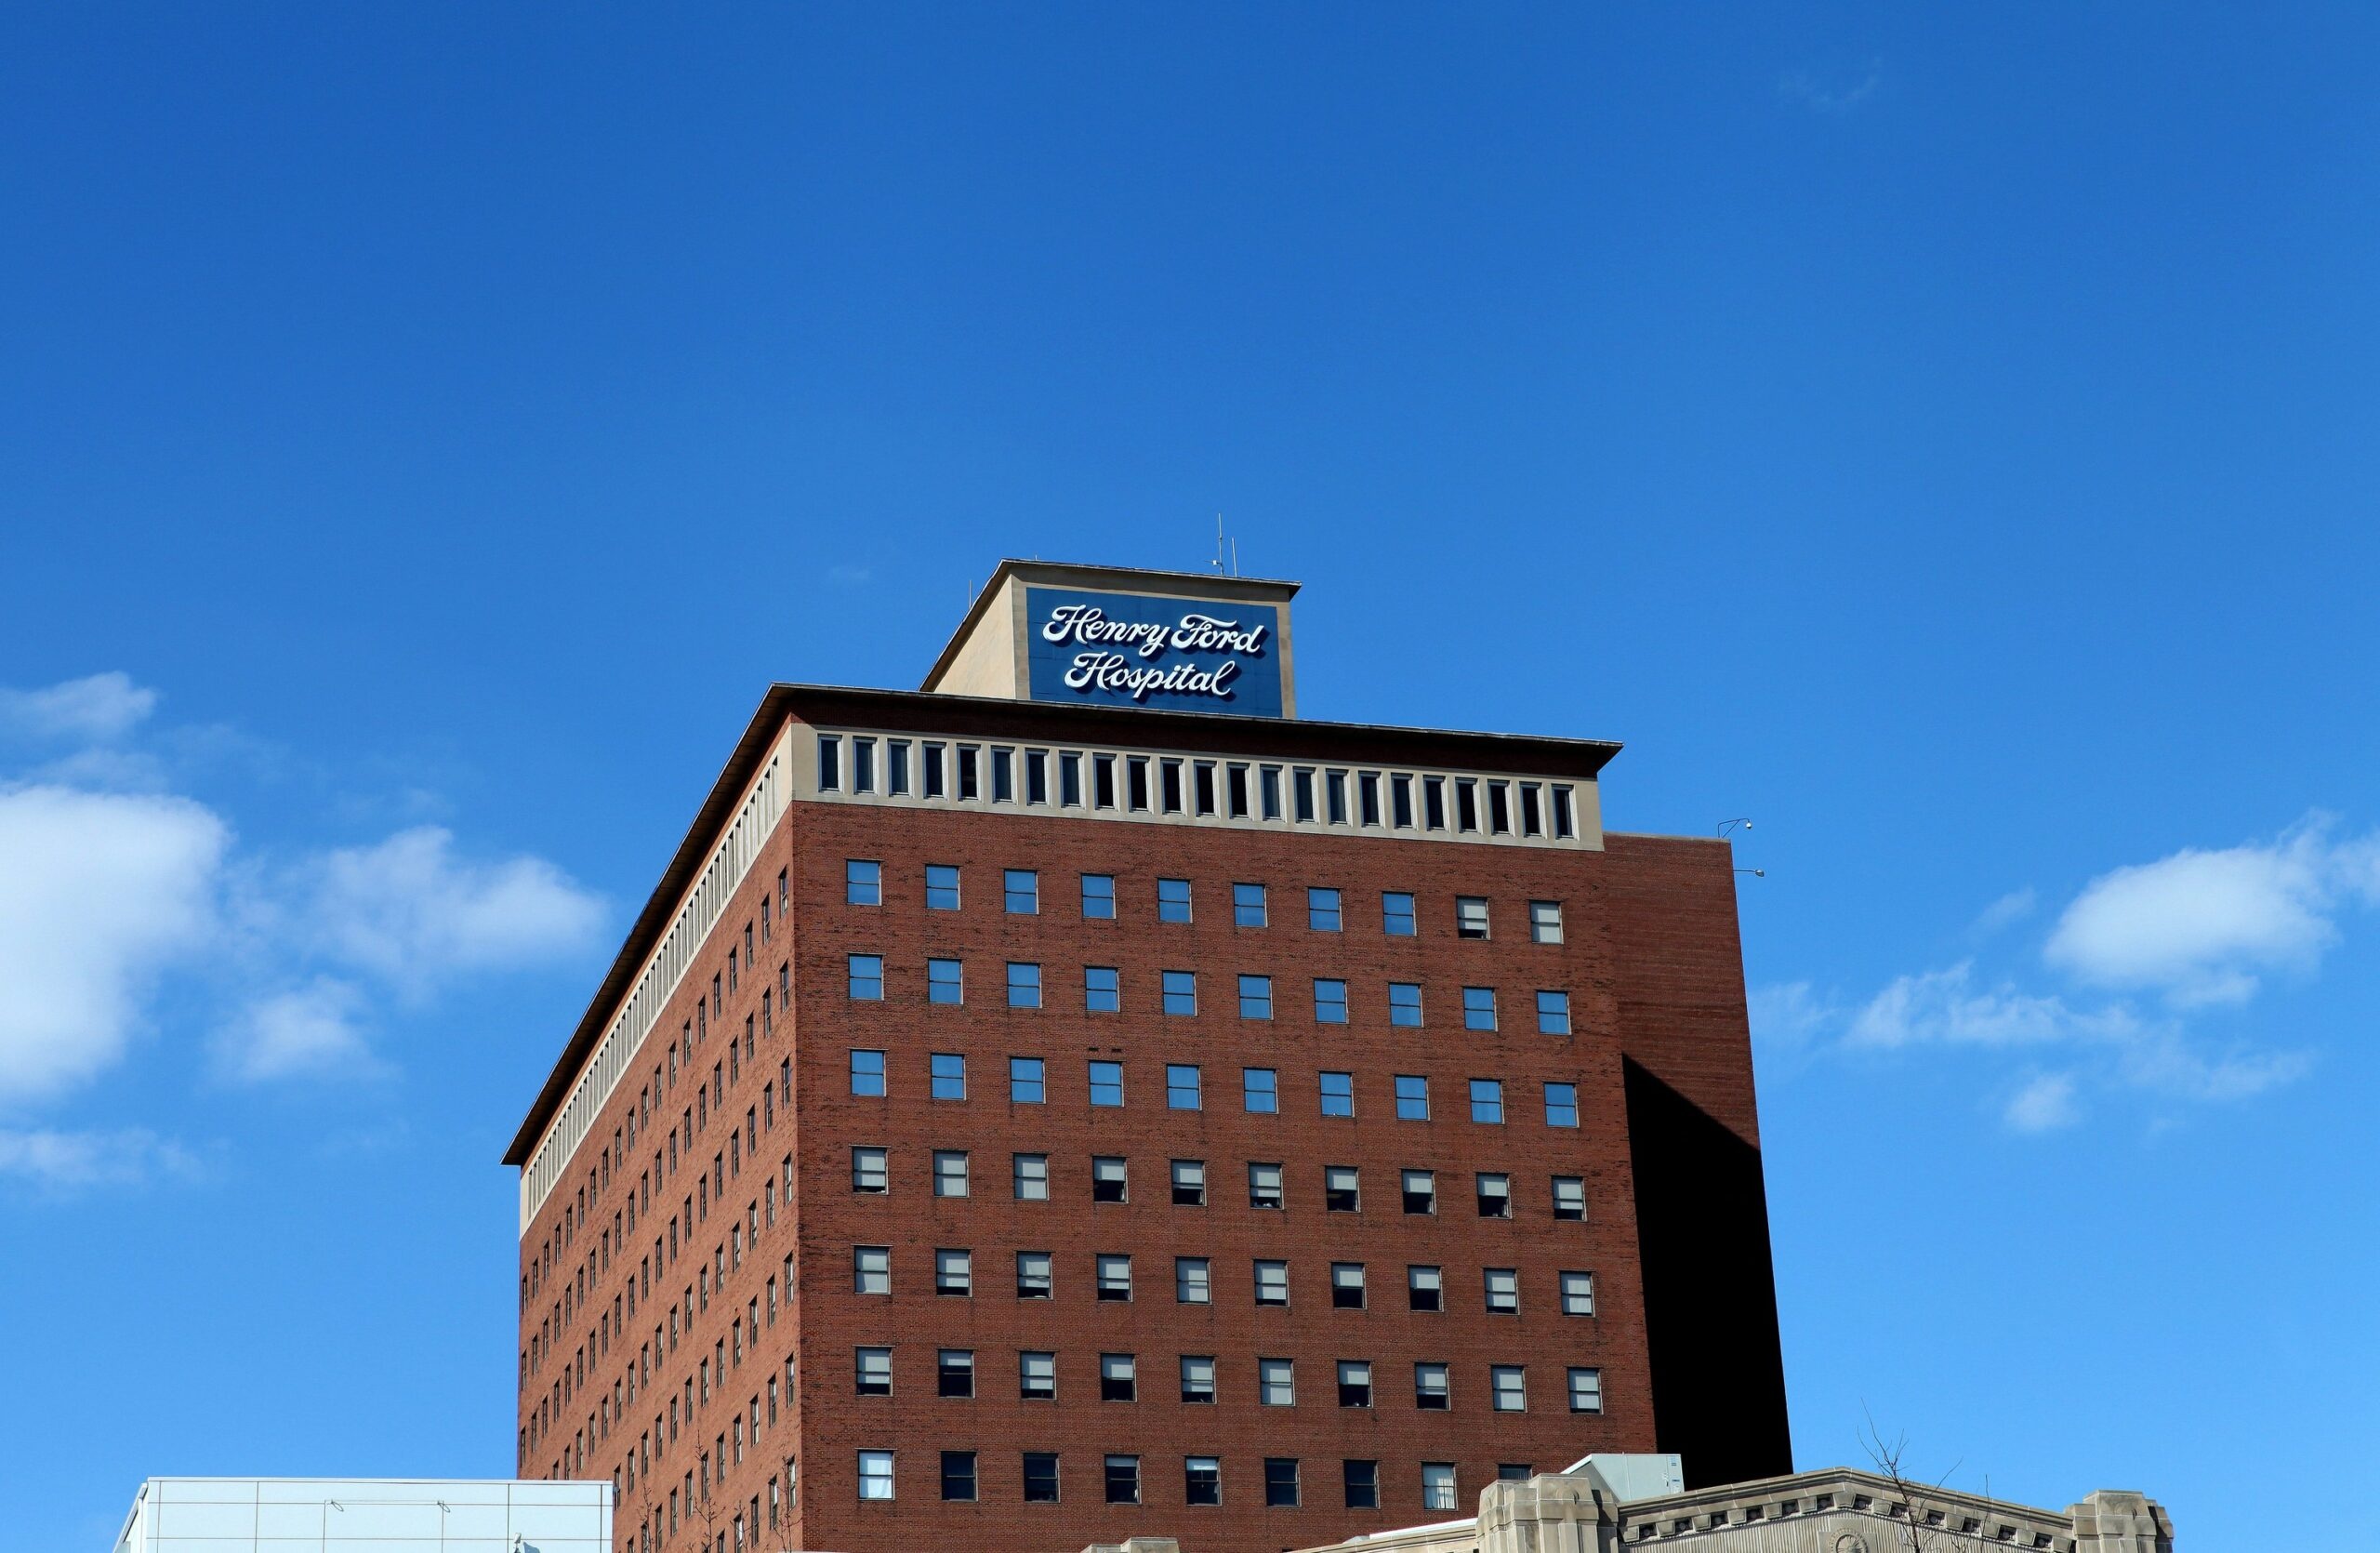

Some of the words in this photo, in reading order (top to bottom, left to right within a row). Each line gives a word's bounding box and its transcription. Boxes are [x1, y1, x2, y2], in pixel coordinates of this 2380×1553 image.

[1042, 604, 1170, 657] Henry
[1170, 614, 1264, 653] Ford
[1064, 652, 1236, 698] Hospital
